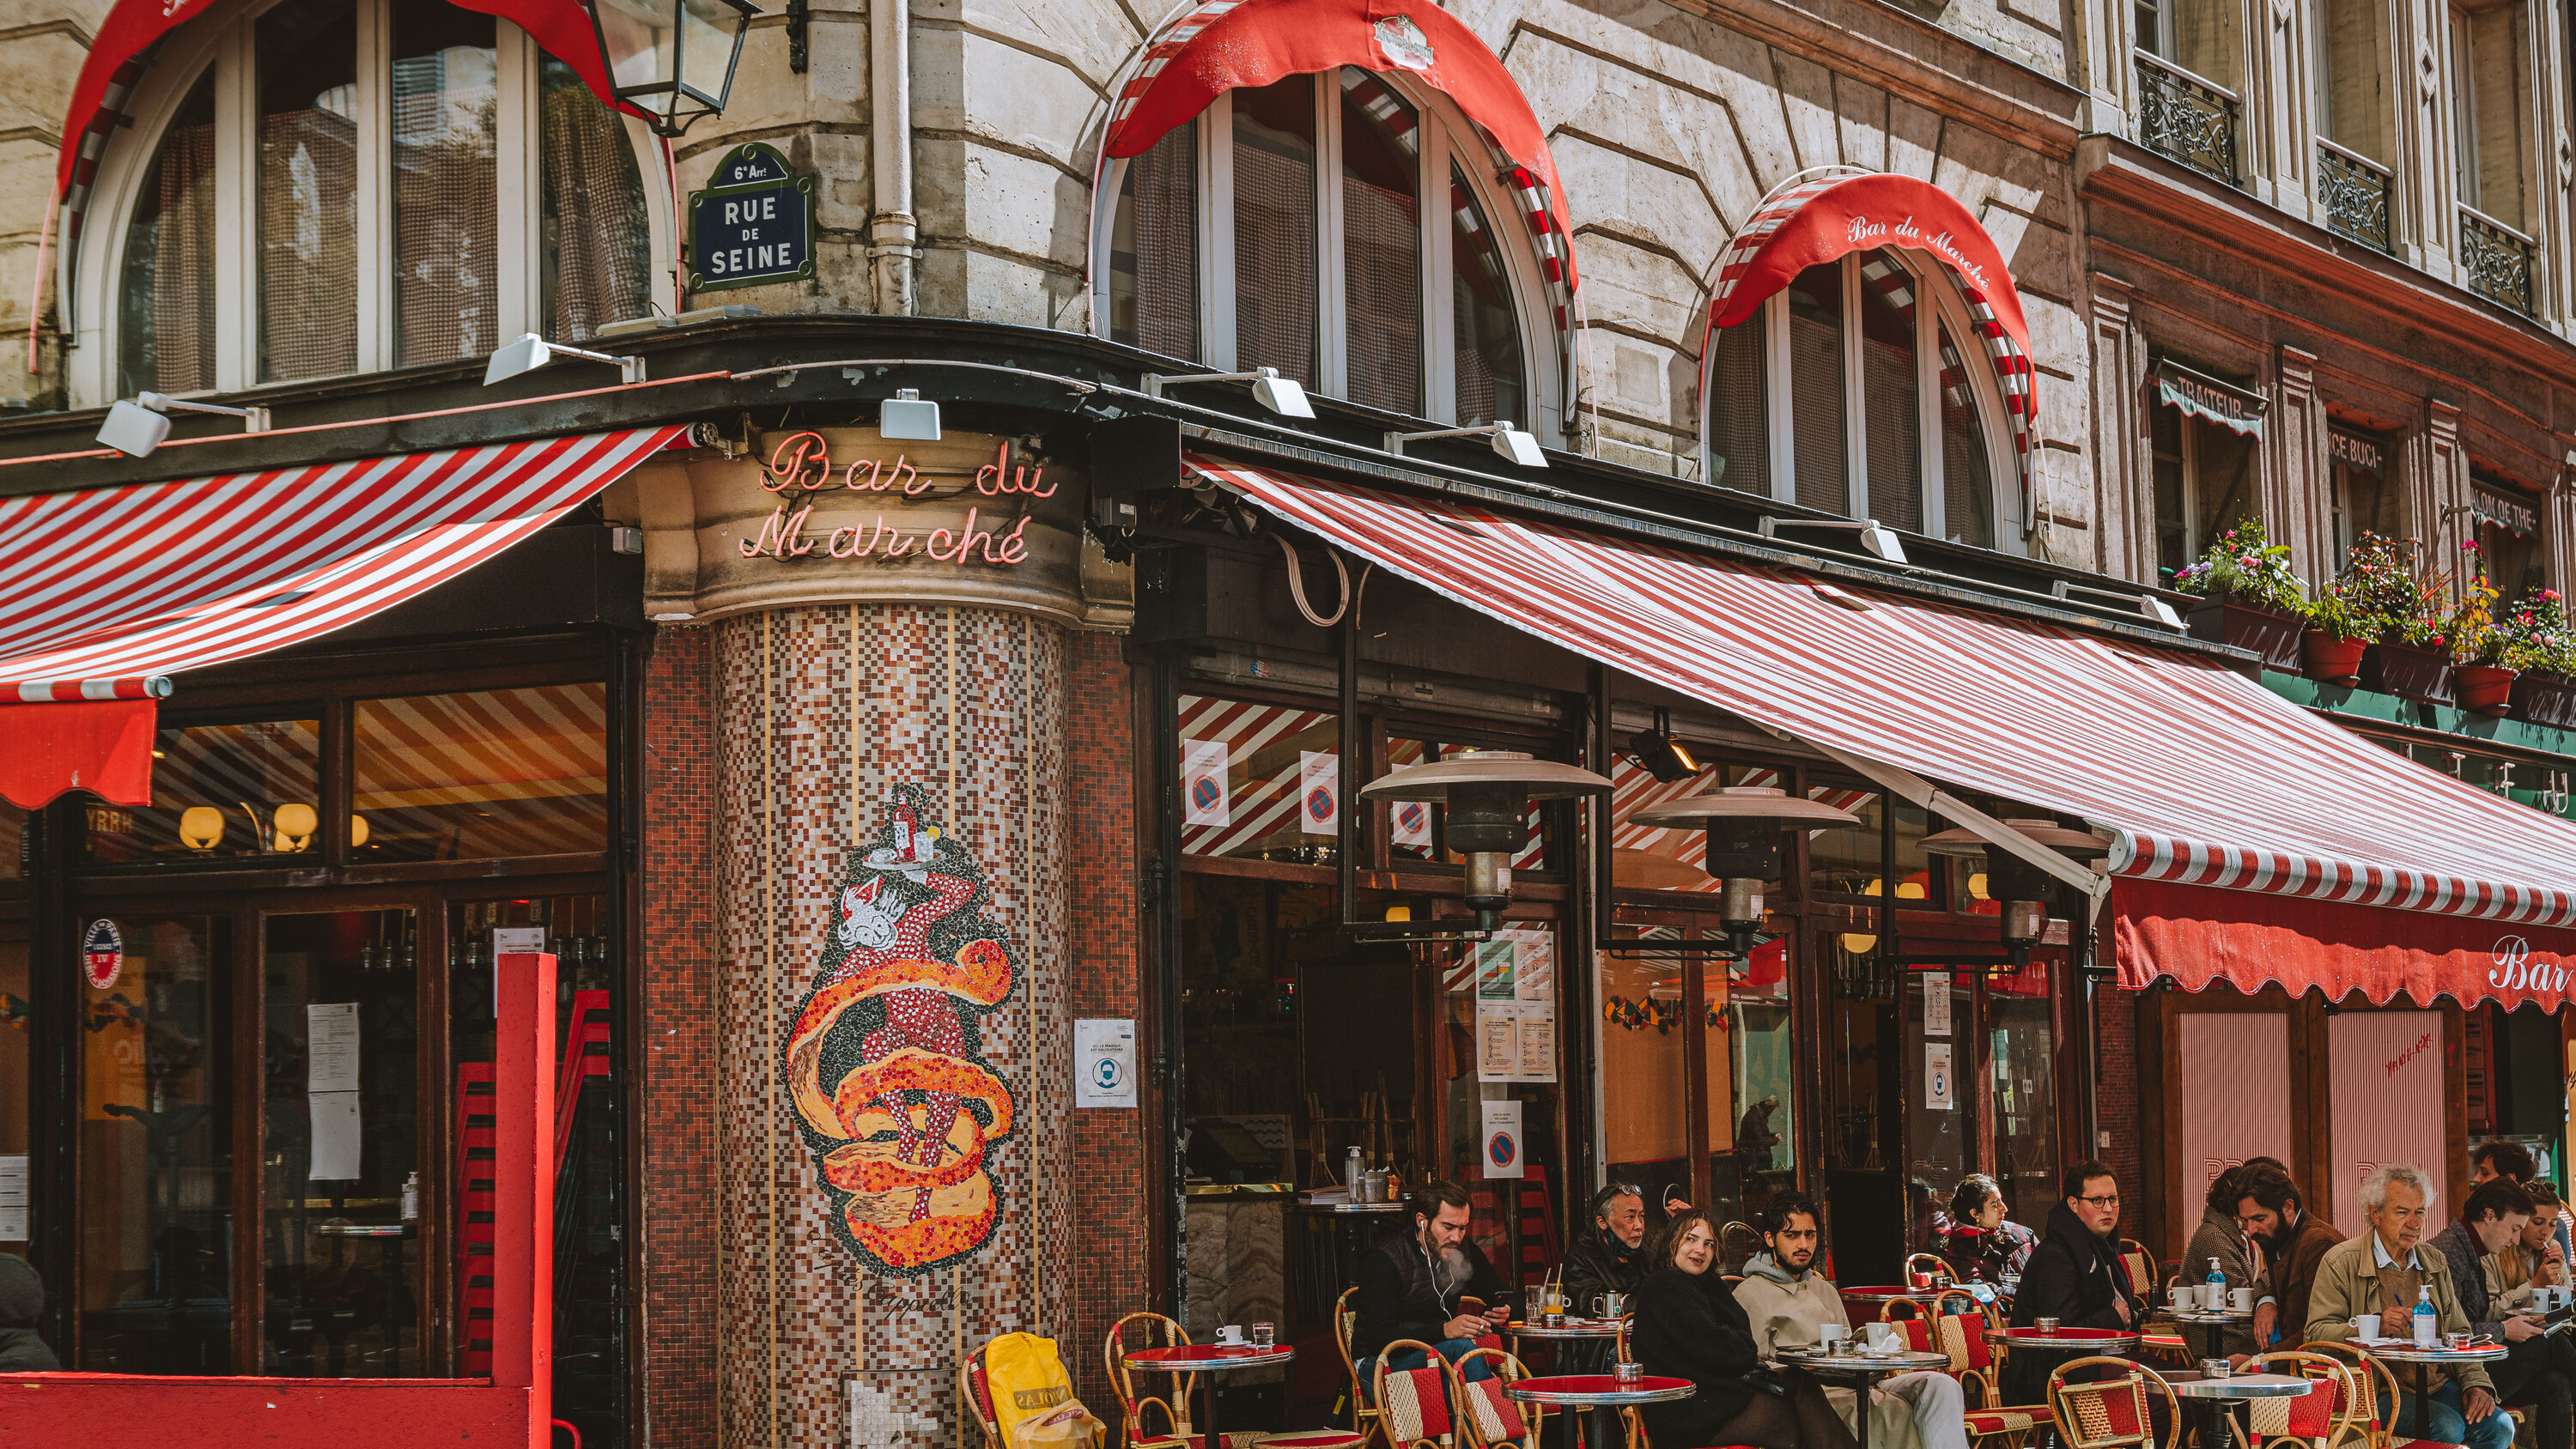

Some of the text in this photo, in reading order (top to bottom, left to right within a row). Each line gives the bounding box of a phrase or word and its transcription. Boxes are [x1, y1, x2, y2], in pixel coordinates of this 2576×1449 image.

[1373, 21, 1434, 65] Kronenbourg
[725, 197, 776, 225] RUE
[742, 227, 759, 241] DE
[1847, 215, 1991, 291] Bar du Marché
[711, 243, 792, 275] SEINE
[2178, 376, 2243, 420] TRAITEUR
[759, 431, 1059, 498] Bar du
[738, 505, 1032, 565] Marché
[86, 925, 98, 948] VILLE
[106, 924, 121, 946] PARIS
[97, 954, 108, 963] IV
[2488, 934, 2574, 992] Bar
